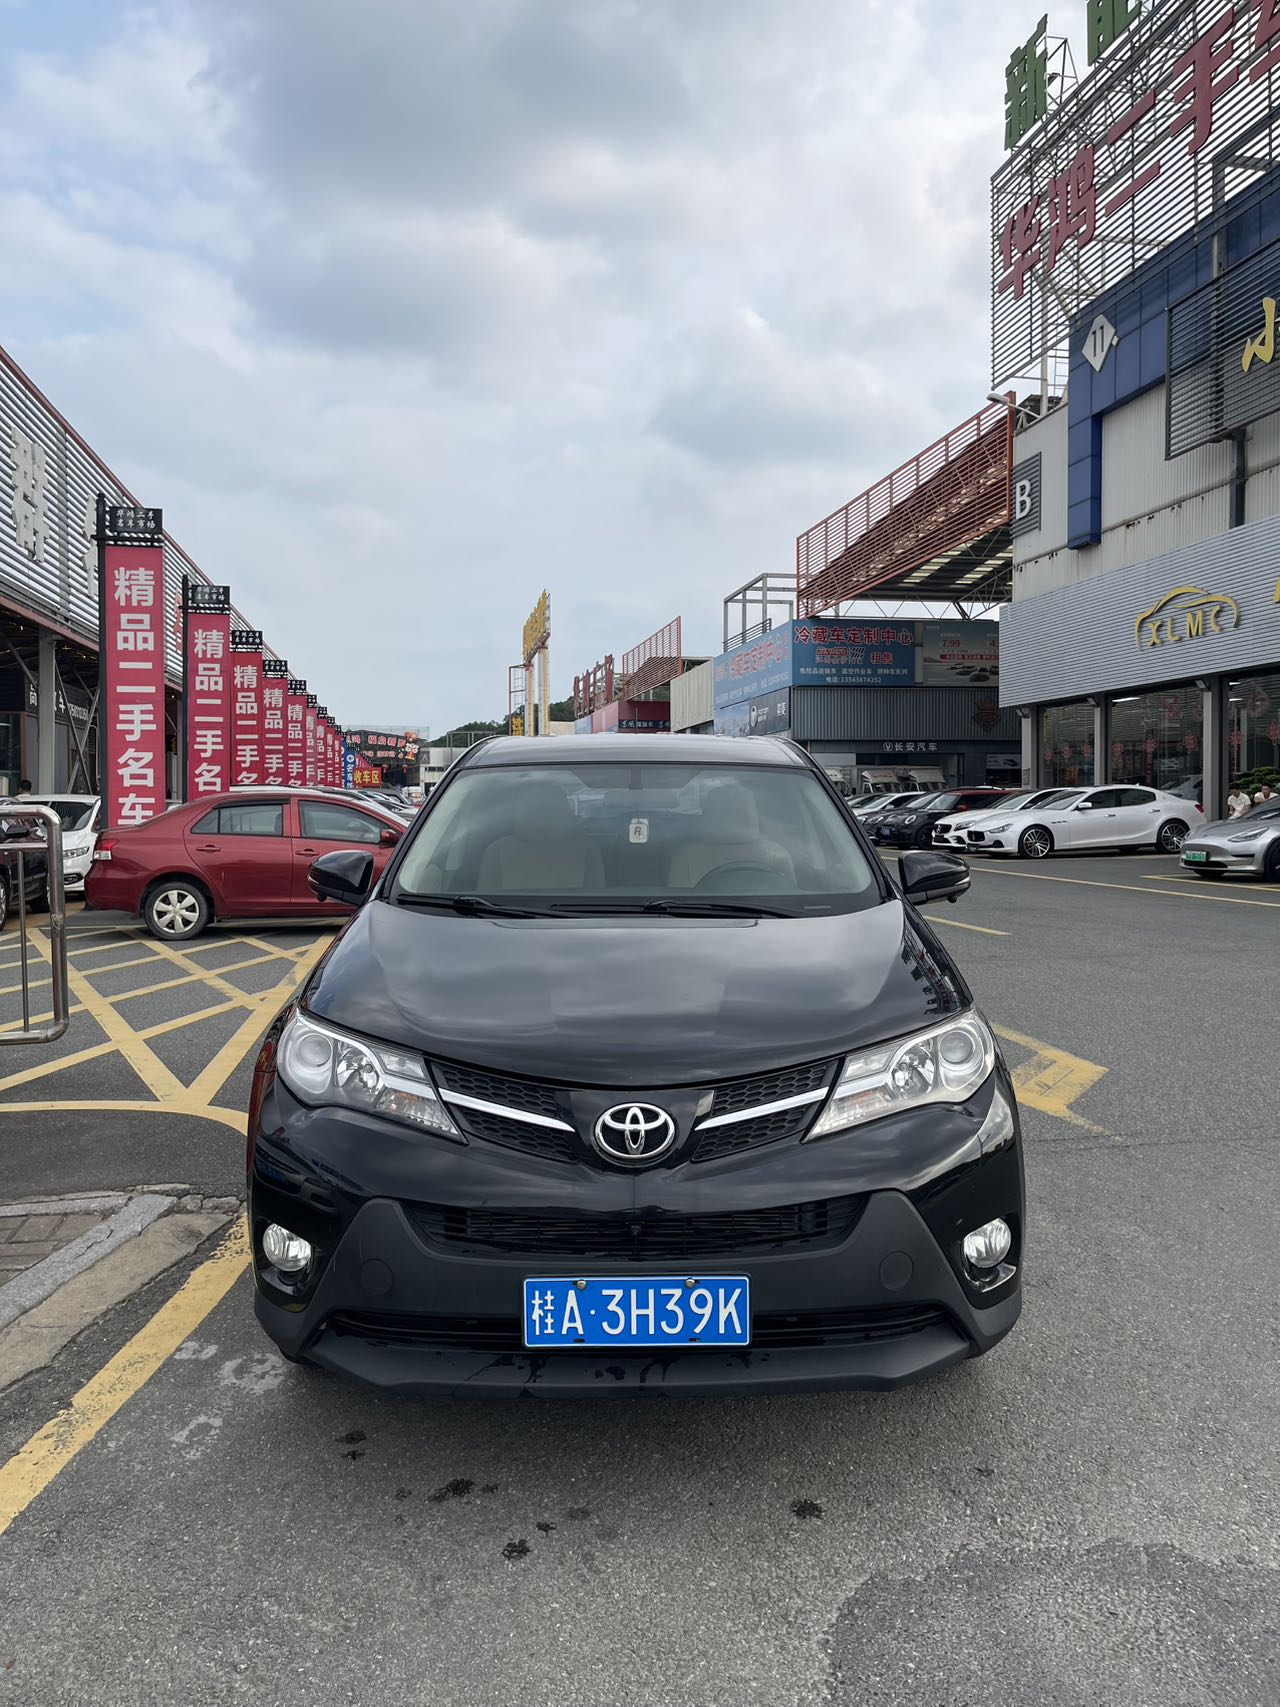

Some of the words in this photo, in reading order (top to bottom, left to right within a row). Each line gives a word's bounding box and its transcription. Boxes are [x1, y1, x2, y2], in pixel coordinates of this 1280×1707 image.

[1091, 324, 1106, 358] 11
[1015, 479, 1031, 520] B
[793, 626, 914, 646] 冷藏车定制中心
[1147, 605, 1222, 646] XLMC
[894, 742, 938, 752] 长安汽车
[354, 769, 381, 785] 收车区
[531, 1288, 743, 1336] 桂A·3H39K
